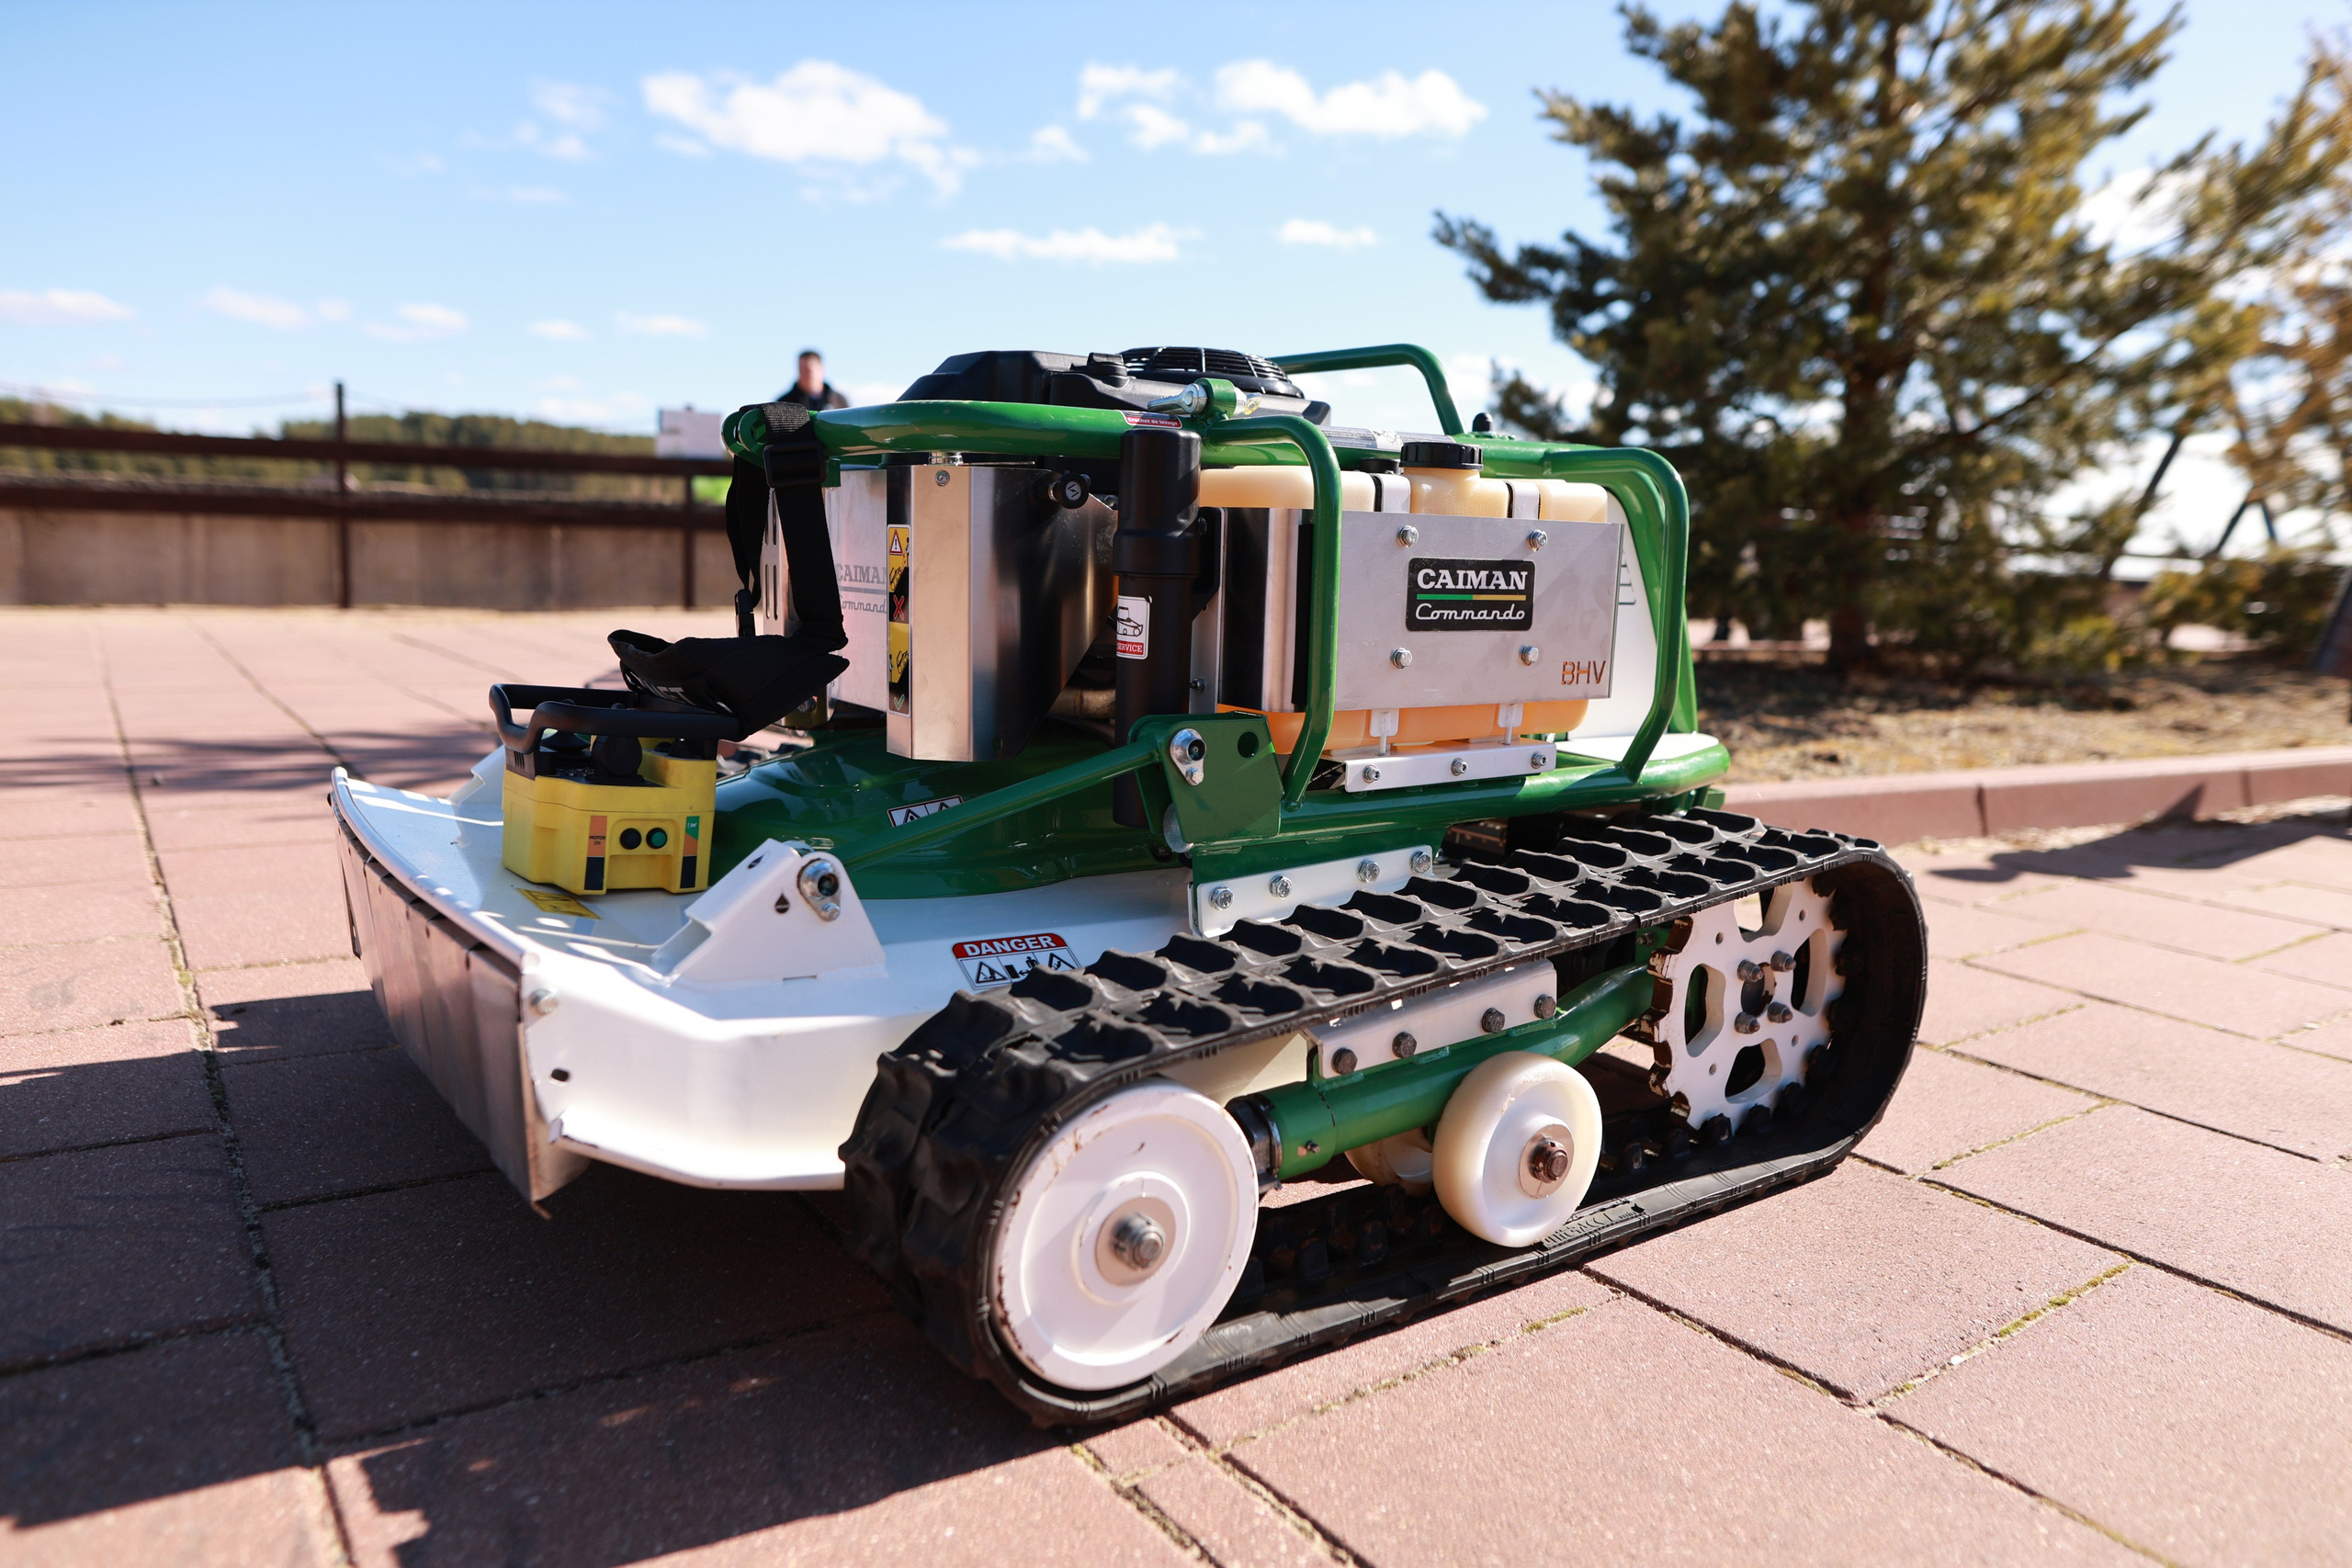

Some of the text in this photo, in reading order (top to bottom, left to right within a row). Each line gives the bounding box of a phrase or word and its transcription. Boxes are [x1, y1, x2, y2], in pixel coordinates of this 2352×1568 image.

[1417, 569, 1528, 590] CAIMAN
[840, 595, 887, 614] ommand
[1416, 603, 1525, 621] Commando
[1561, 660, 1606, 684] BHV
[963, 935, 1057, 956] DANGER
